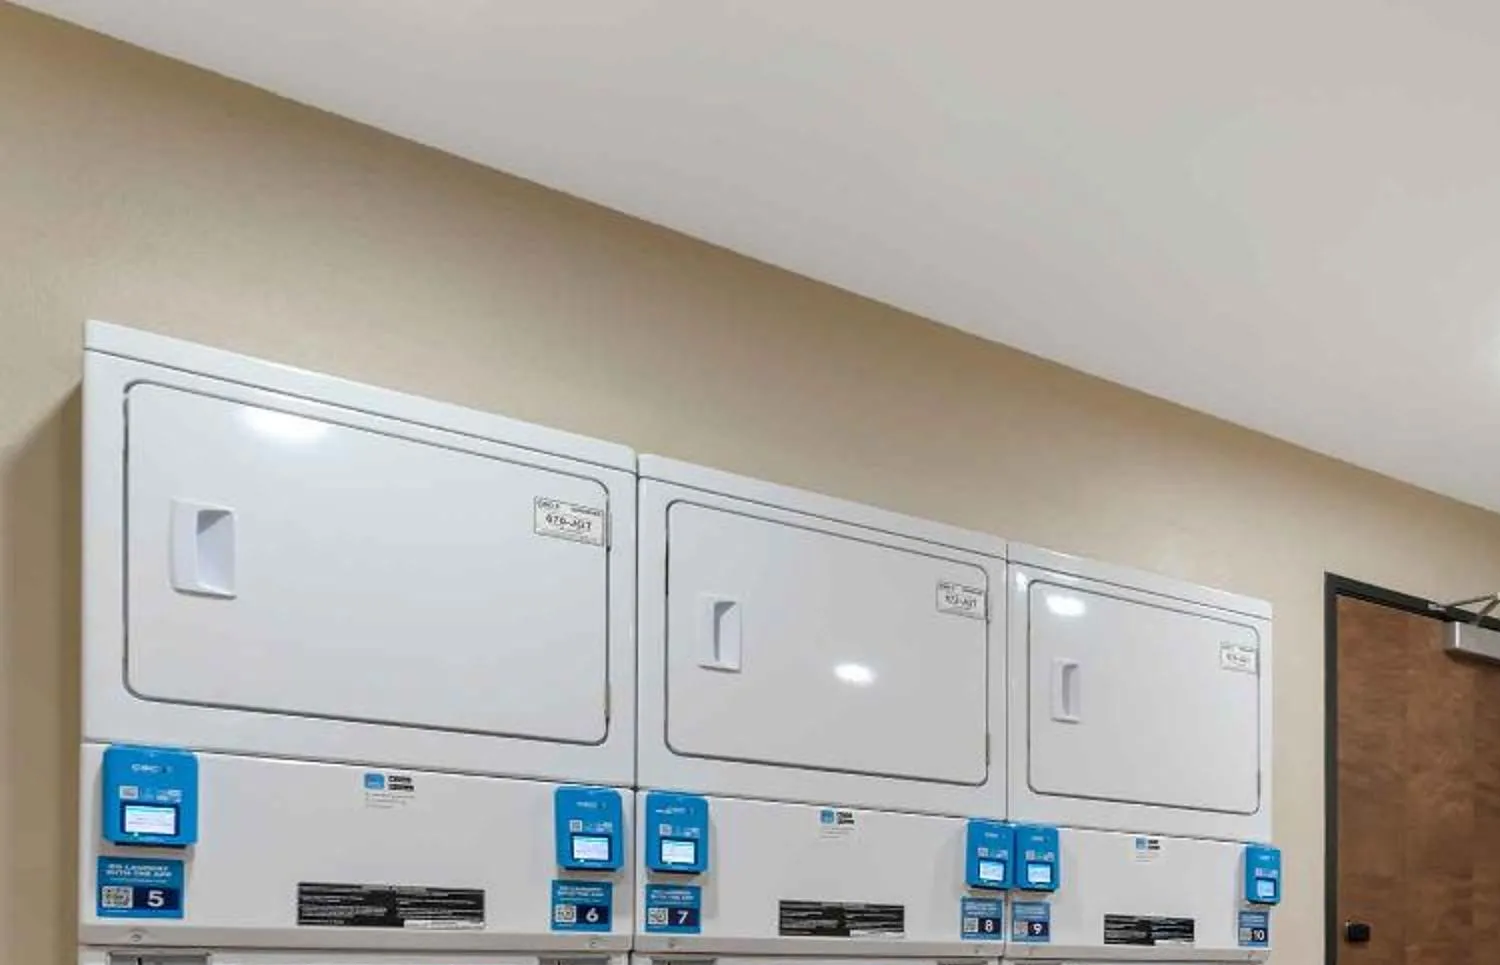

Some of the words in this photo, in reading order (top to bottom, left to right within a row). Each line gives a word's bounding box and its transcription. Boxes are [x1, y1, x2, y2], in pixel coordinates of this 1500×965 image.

[147, 889, 165, 907] 5
[586, 908, 599, 922] 6
[677, 911, 689, 924] 7
[985, 919, 994, 933] 8
